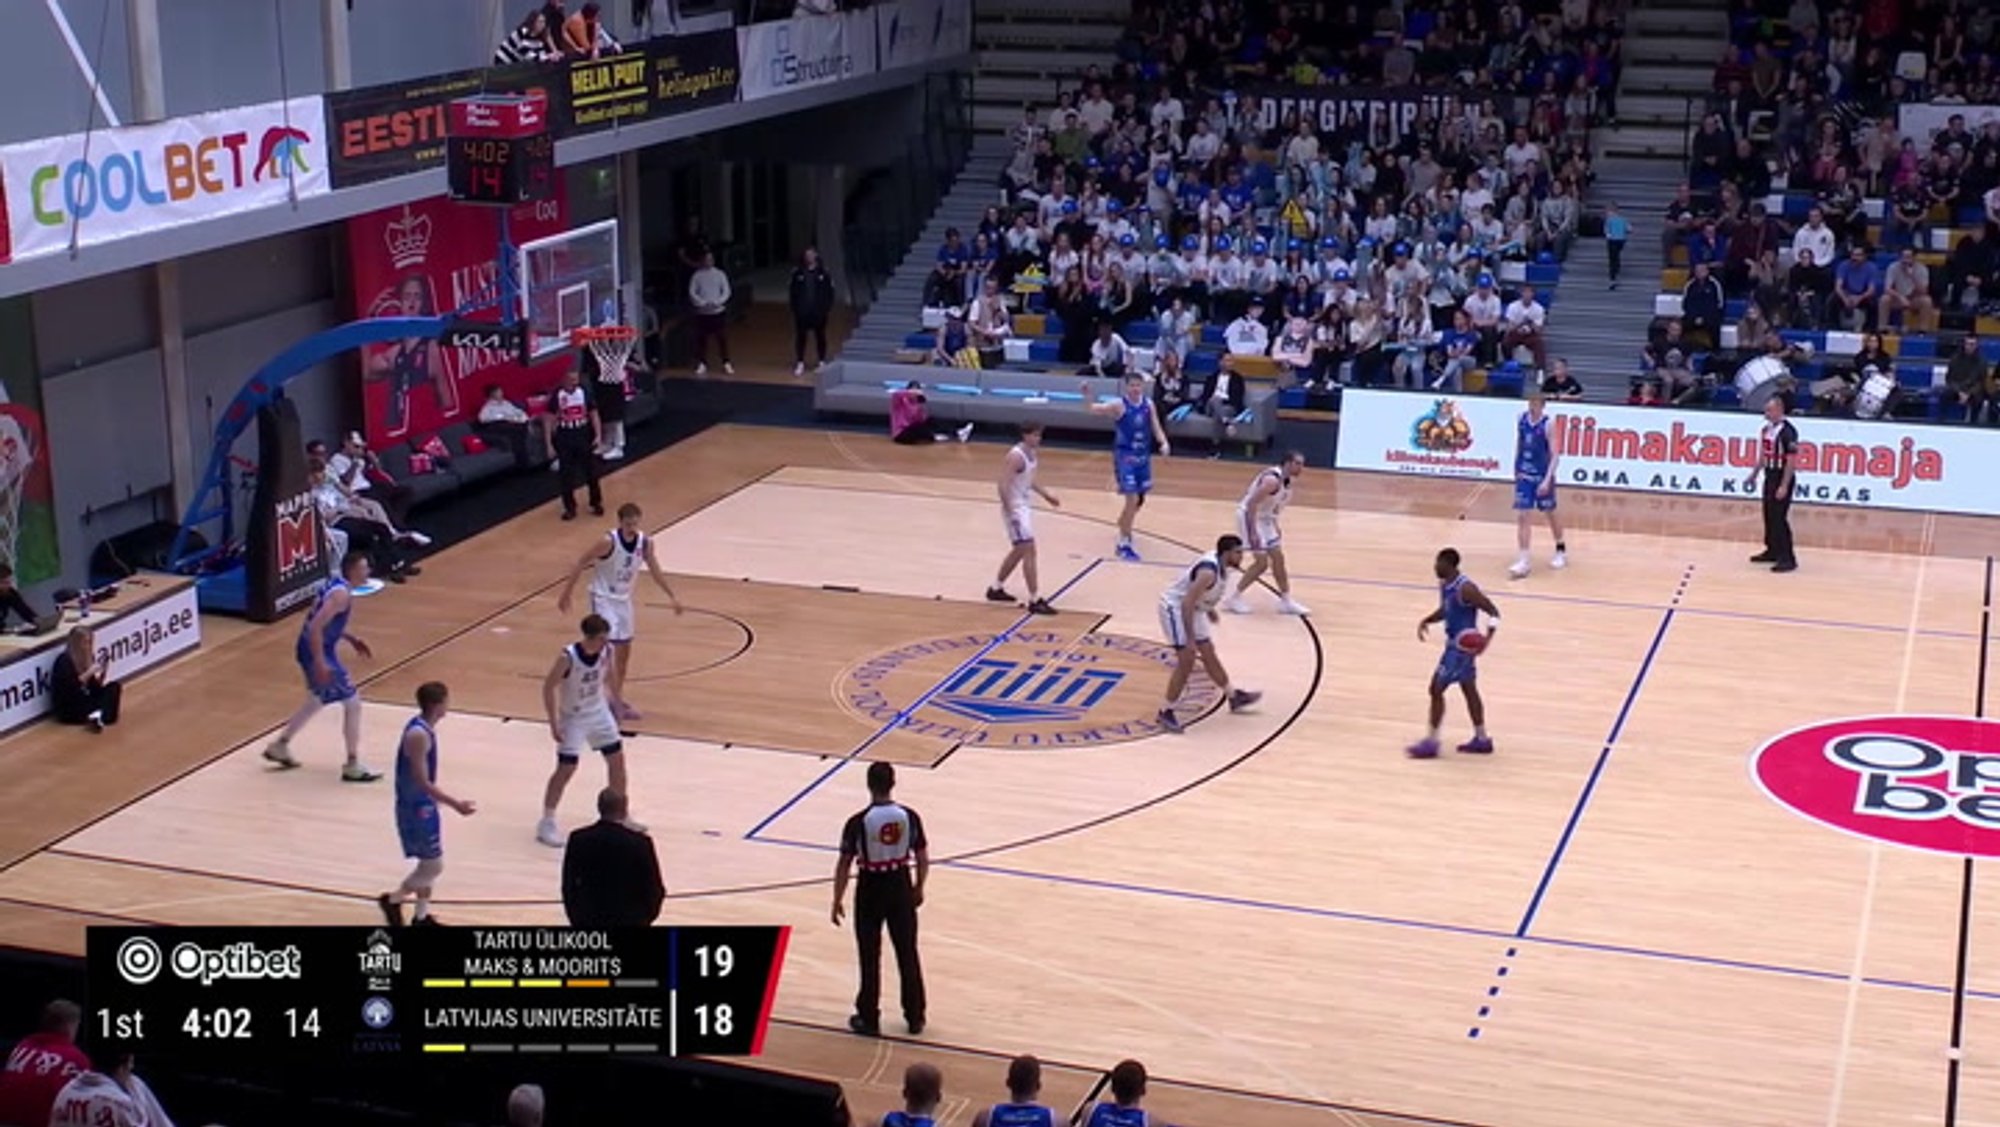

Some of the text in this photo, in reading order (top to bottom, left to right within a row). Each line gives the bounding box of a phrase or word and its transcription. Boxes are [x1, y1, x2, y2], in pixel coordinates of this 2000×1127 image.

[613, 60, 646, 89] PUIT
[341, 104, 448, 158] EESTI
[463, 140, 510, 164] 4:02
[31, 131, 249, 227] COOLBET
[469, 165, 502, 197] 14
[1572, 467, 1630, 485] OMA
[1649, 472, 1702, 490] ALA
